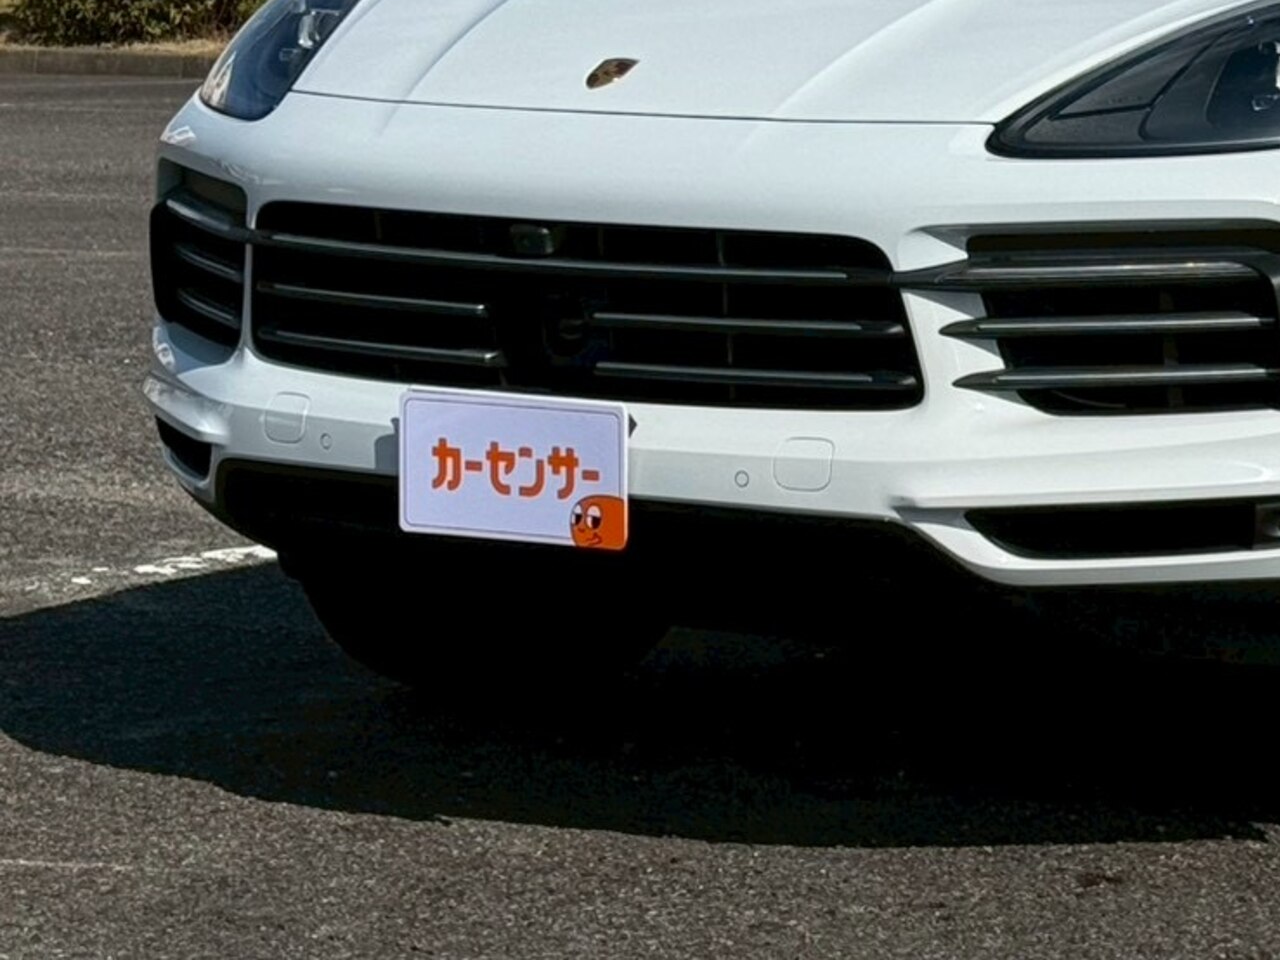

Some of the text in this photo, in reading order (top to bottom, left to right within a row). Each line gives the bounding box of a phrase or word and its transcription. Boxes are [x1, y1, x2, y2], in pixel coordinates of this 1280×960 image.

[431, 437, 600, 500] カーセンサー
